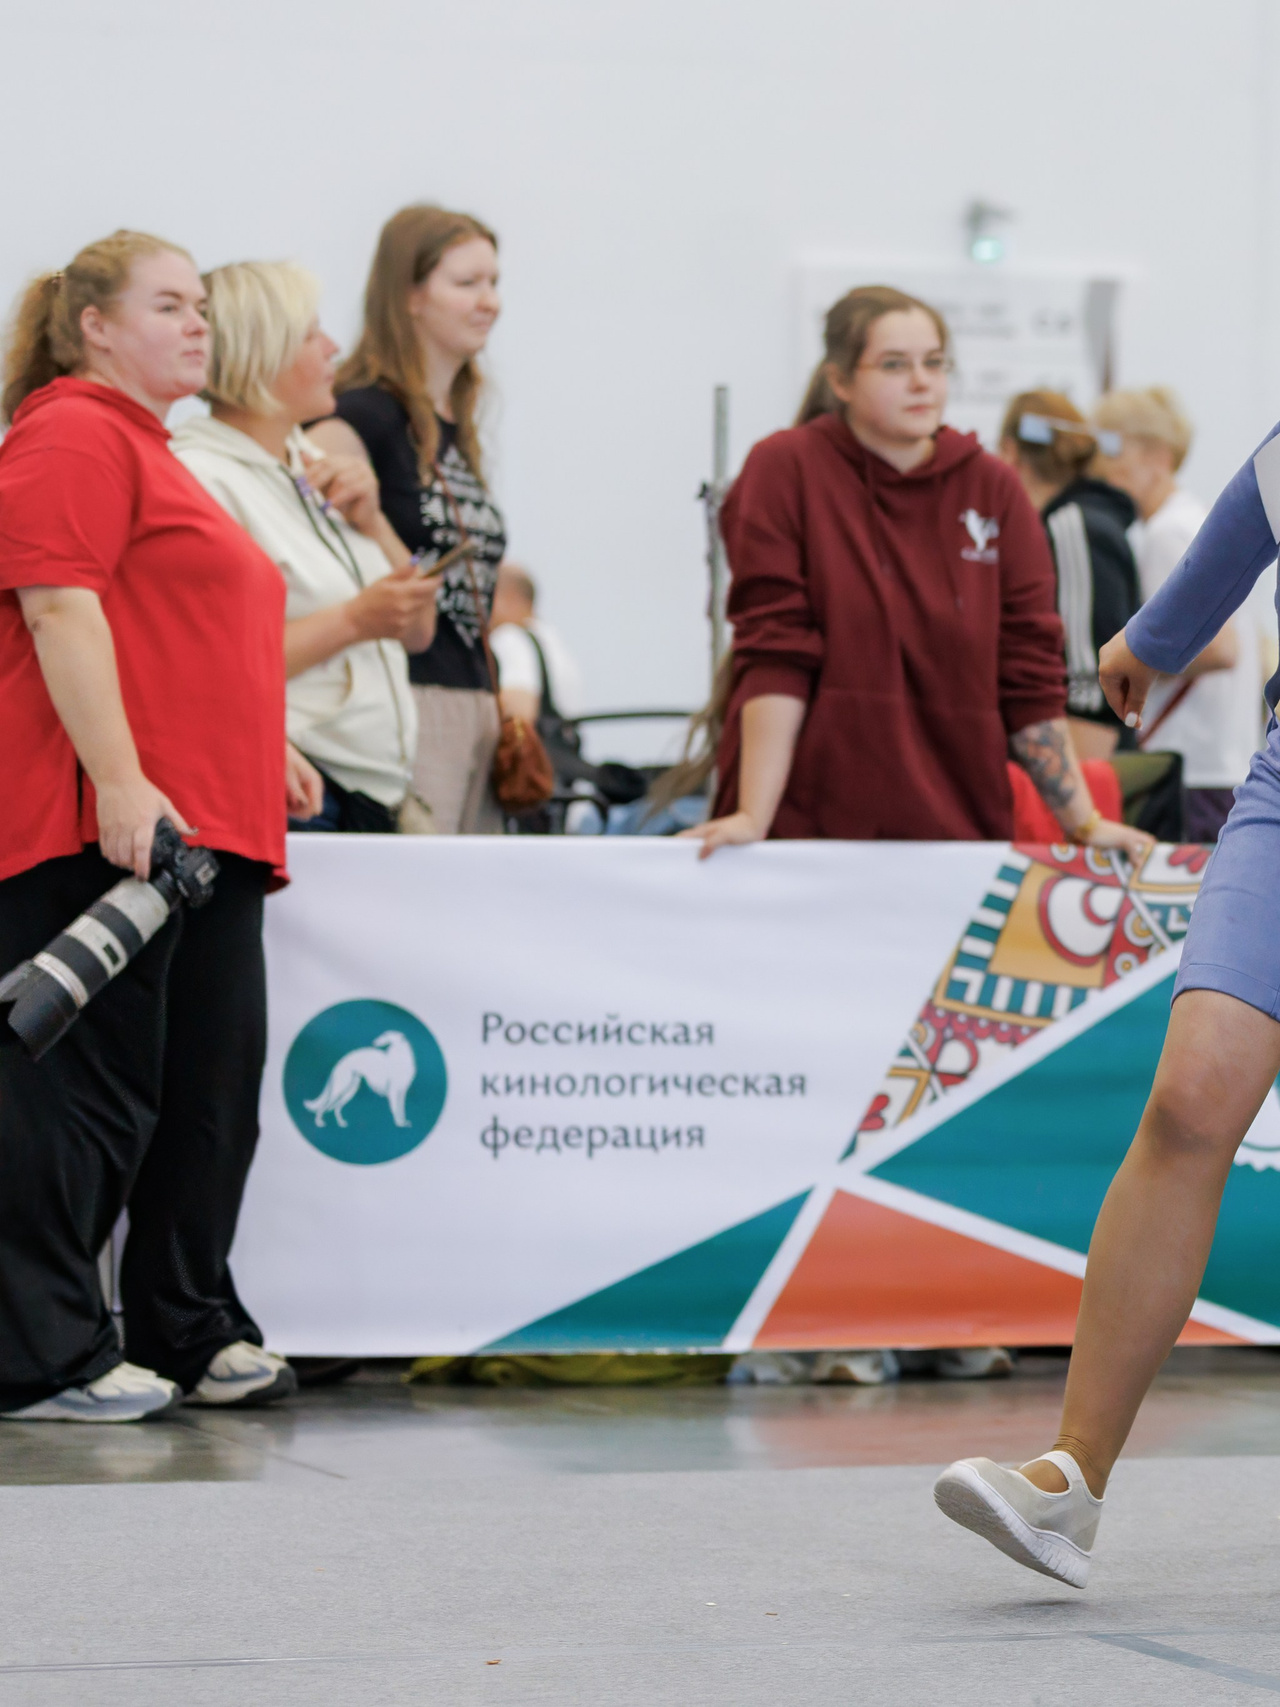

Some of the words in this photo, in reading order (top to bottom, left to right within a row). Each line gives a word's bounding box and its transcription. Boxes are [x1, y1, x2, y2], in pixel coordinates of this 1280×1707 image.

[481, 1011, 715, 1045] Российская
[480, 1072, 807, 1098] кинологическая
[480, 1114, 706, 1160] федерация
